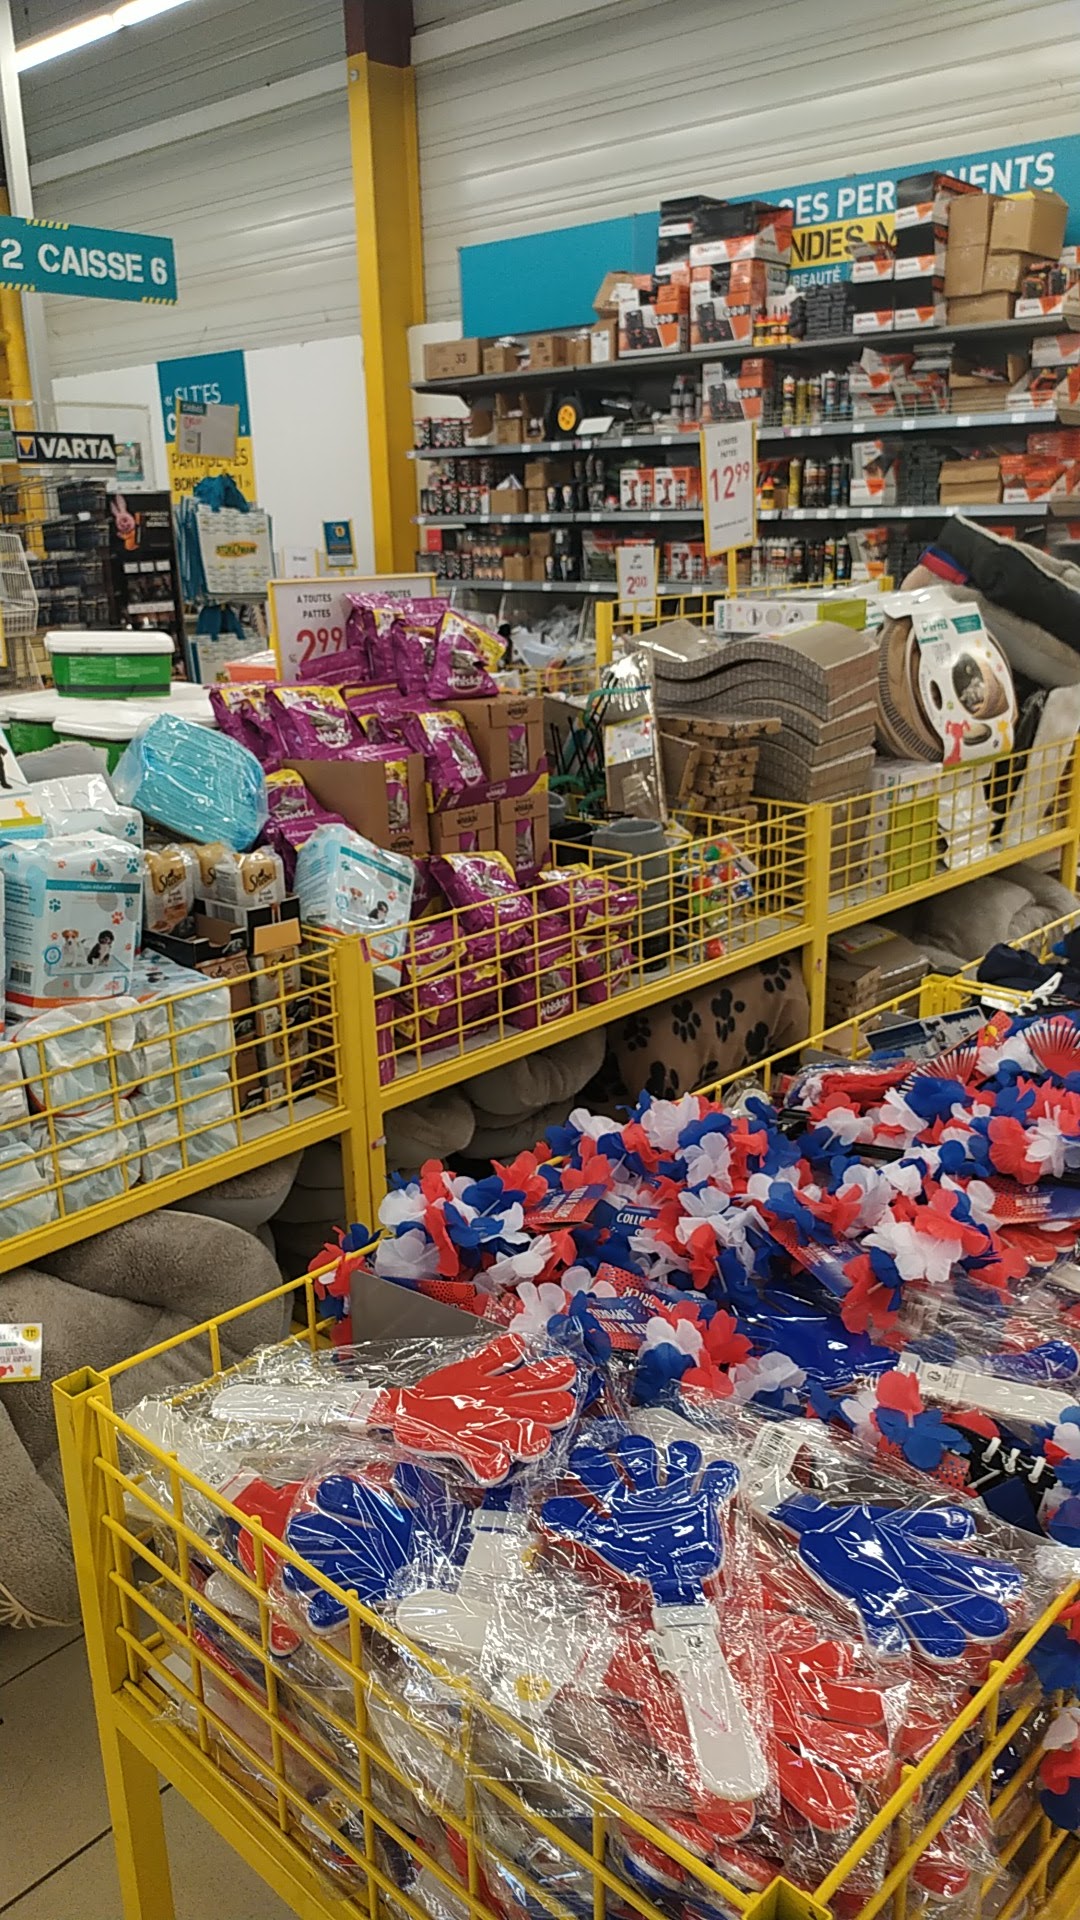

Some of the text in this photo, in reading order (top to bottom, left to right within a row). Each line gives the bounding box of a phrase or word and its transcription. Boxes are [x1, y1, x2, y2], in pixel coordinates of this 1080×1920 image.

[0, 238, 168, 285] 2 CAISSE 6
[38, 437, 116, 460] VARTA
[303, 593, 333, 604] TOUTES
[302, 608, 332, 619] PATTES
